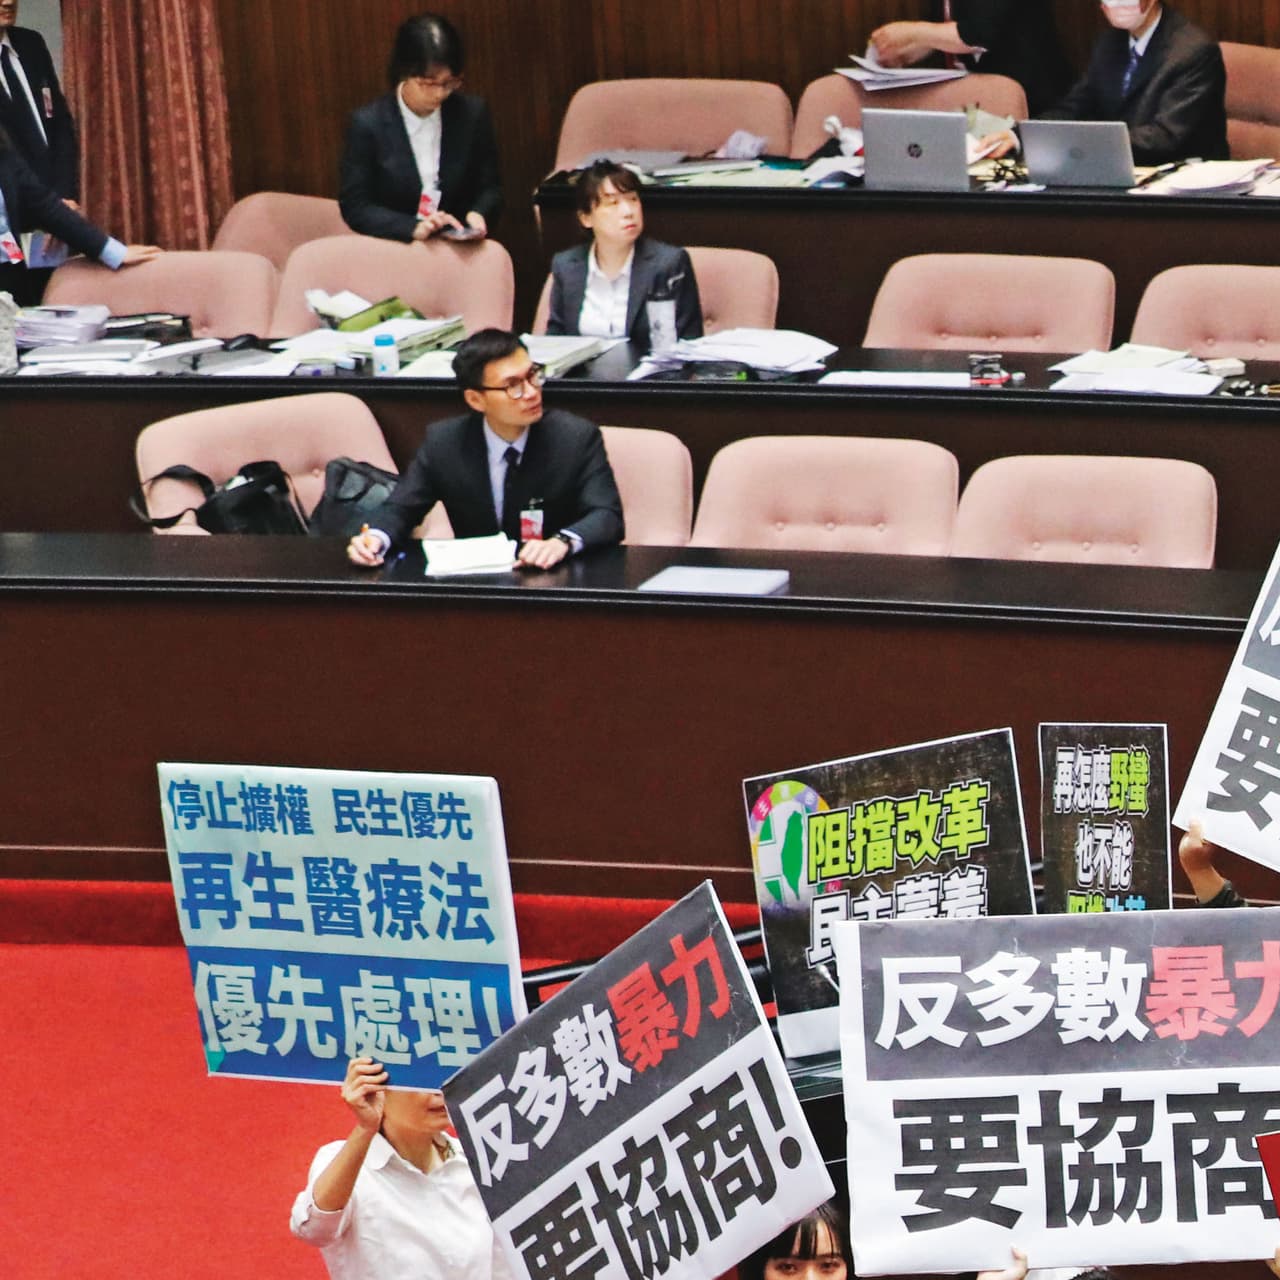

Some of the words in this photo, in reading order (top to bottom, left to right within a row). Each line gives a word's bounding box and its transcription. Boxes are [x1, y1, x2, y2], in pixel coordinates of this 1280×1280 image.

[167, 779, 314, 836] 停止擴權
[332, 787, 473, 841] 民生優先
[1054, 745, 1151, 814] 再怎麼野蠻
[807, 779, 990, 885] 阻擋改革
[1076, 819, 1134, 890] 也不能
[178, 851, 496, 945] 再生醫療法
[194, 960, 502, 1067] 優先處理!
[459, 934, 732, 1188] 反多數暴力
